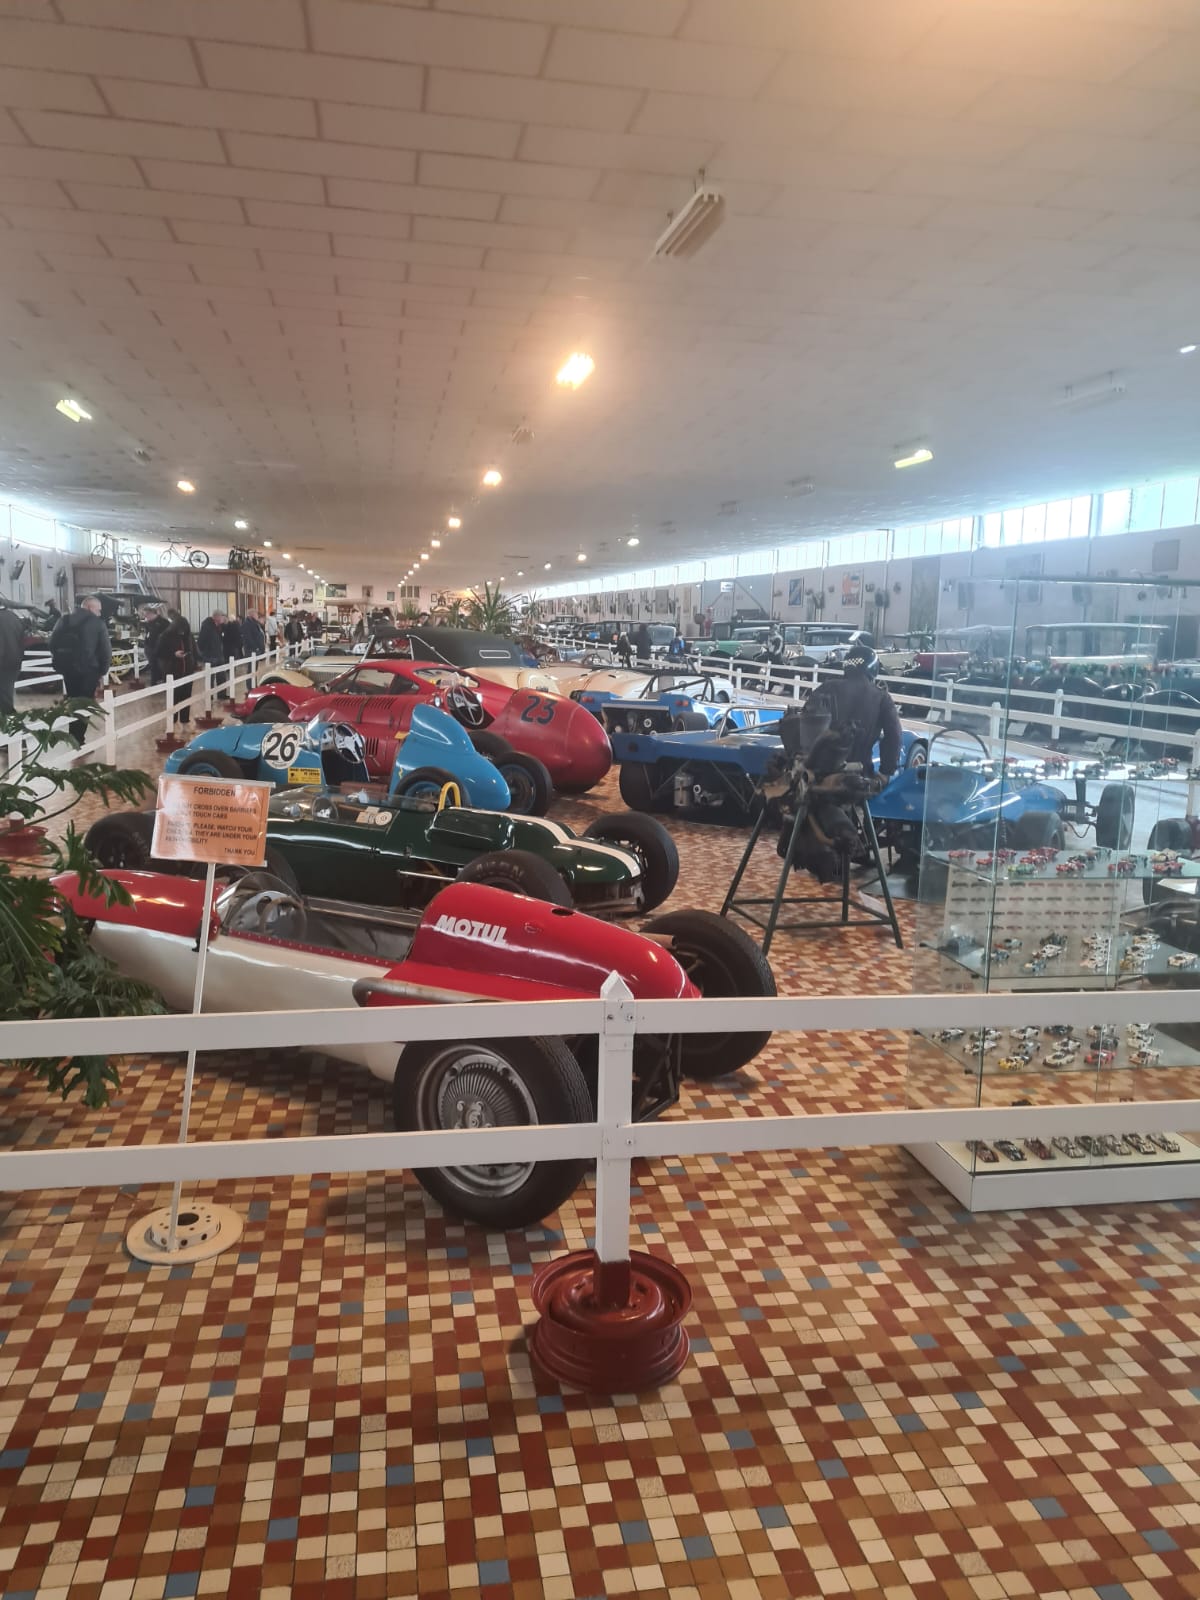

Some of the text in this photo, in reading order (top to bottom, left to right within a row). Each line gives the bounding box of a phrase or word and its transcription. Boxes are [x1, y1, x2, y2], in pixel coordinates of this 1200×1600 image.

[521, 695, 558, 725] 23
[264, 732, 298, 762] 26
[193, 786, 236, 797] FORBIDDEN
[434, 915, 508, 944] MOTUL
